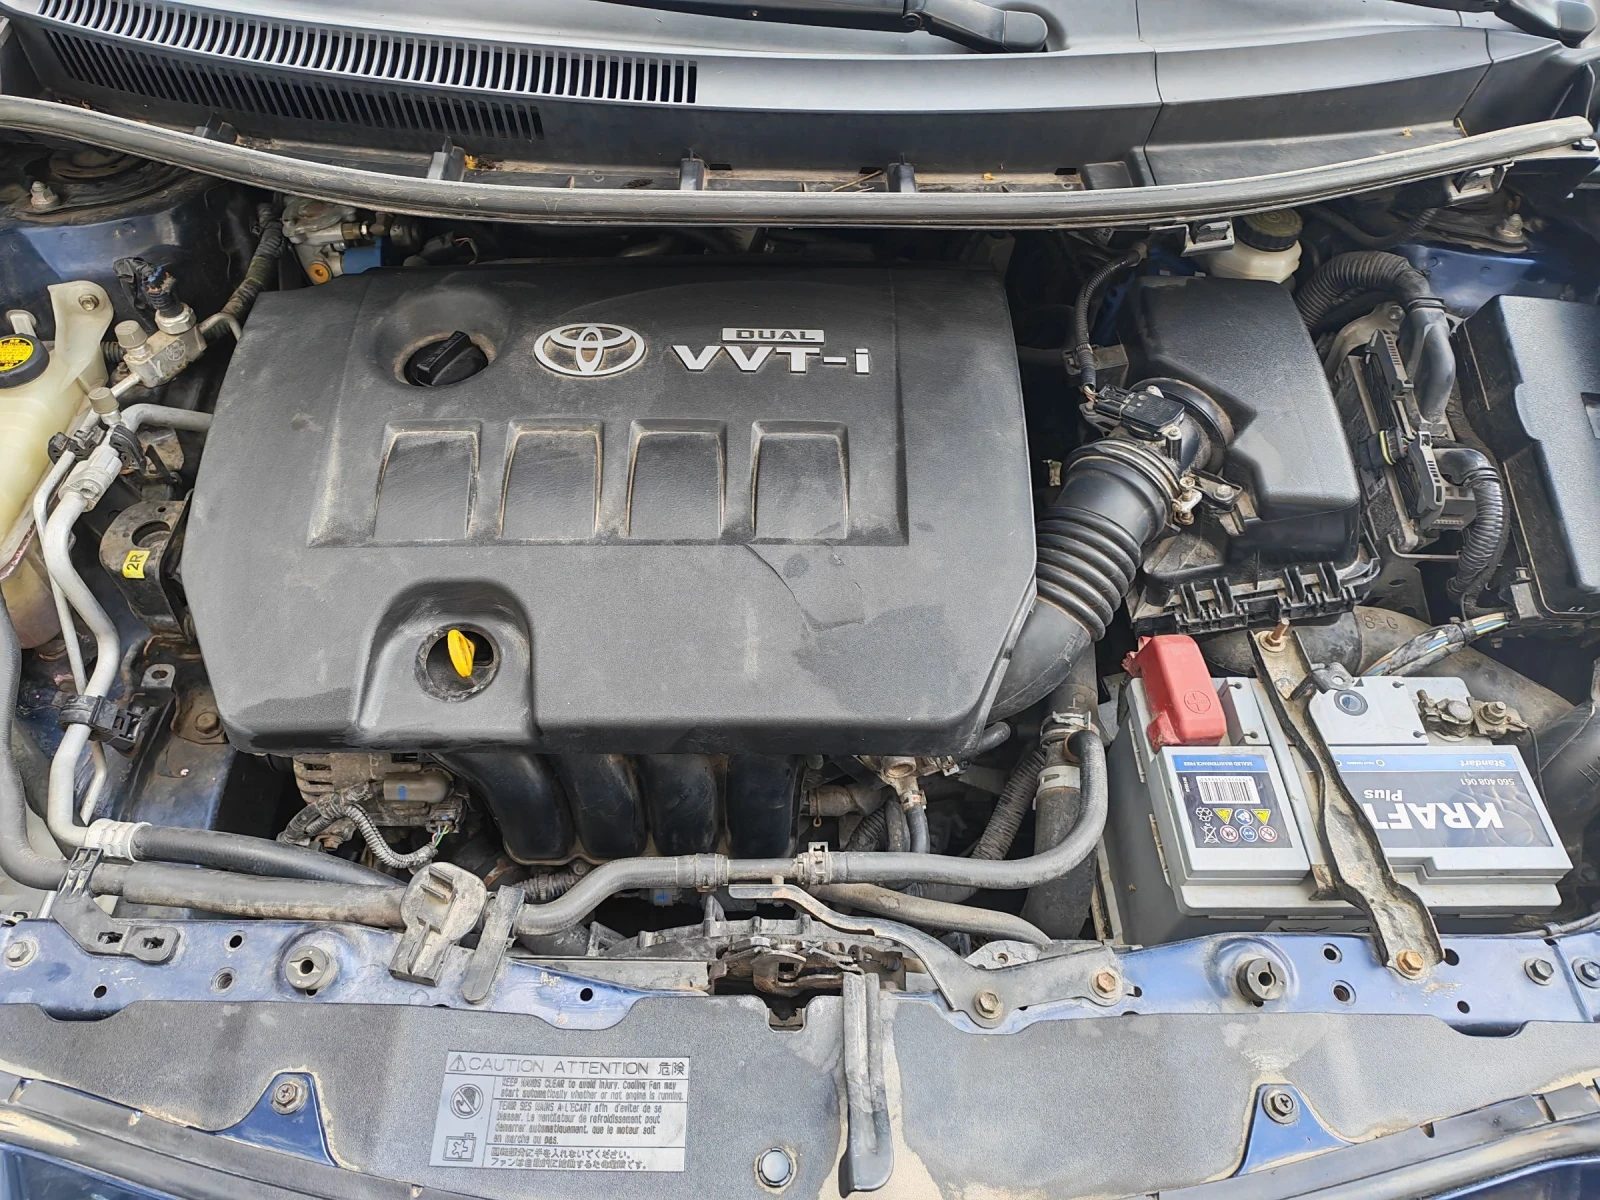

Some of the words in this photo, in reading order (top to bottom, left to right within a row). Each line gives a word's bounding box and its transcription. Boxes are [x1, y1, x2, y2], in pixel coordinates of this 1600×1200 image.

[736, 329, 816, 340] DUAL
[672, 344, 870, 374] VVT-i
[126, 554, 144, 570] 2R
[1460, 759, 1506, 768] Standart
[1460, 778, 1478, 786] 061
[1478, 778, 1496, 786] 408
[1498, 778, 1516, 786] 560
[1364, 789, 1402, 802] Plus
[1362, 802, 1504, 830] KRAFT
[468, 1057, 544, 1073] CAUTION
[554, 1060, 648, 1075] ATTENTION
[658, 1062, 686, 1076] 危険
[502, 1078, 518, 1086] KEEP
[521, 1078, 542, 1088] HANDS
[544, 1079, 565, 1088] CLEAR
[569, 1080, 576, 1088] to
[579, 1080, 596, 1089] avoid
[649, 1081, 660, 1090] Fan
[664, 1082, 676, 1091] may
[501, 1088, 519, 1098] start
[522, 1089, 568, 1099] automatically
[571, 1090, 598, 1099] whether
[600, 1092, 608, 1100] or
[611, 1091, 622, 1100] not
[626, 1092, 646, 1101] engine
[649, 1091, 655, 1100] is
[519, 1102, 532, 1111] SES
[535, 1103, 554, 1111] MAINS
[595, 1103, 608, 1112] afin
[642, 1104, 650, 1113] de
[527, 1113, 535, 1122] Le
[538, 1113, 575, 1123] ventilateur
[579, 1114, 587, 1123] de
[590, 1114, 642, 1124] refroidissement
[645, 1115, 661, 1124] peut
[592, 1126, 604, 1134] que
[607, 1125, 613, 1134] le
[616, 1126, 639, 1134] moteur
[643, 1126, 656, 1134] soit
[493, 1134, 502, 1142] en
[505, 1134, 530, 1143] marche
[533, 1136, 542, 1144] ou
[544, 1136, 559, 1144] pas.
